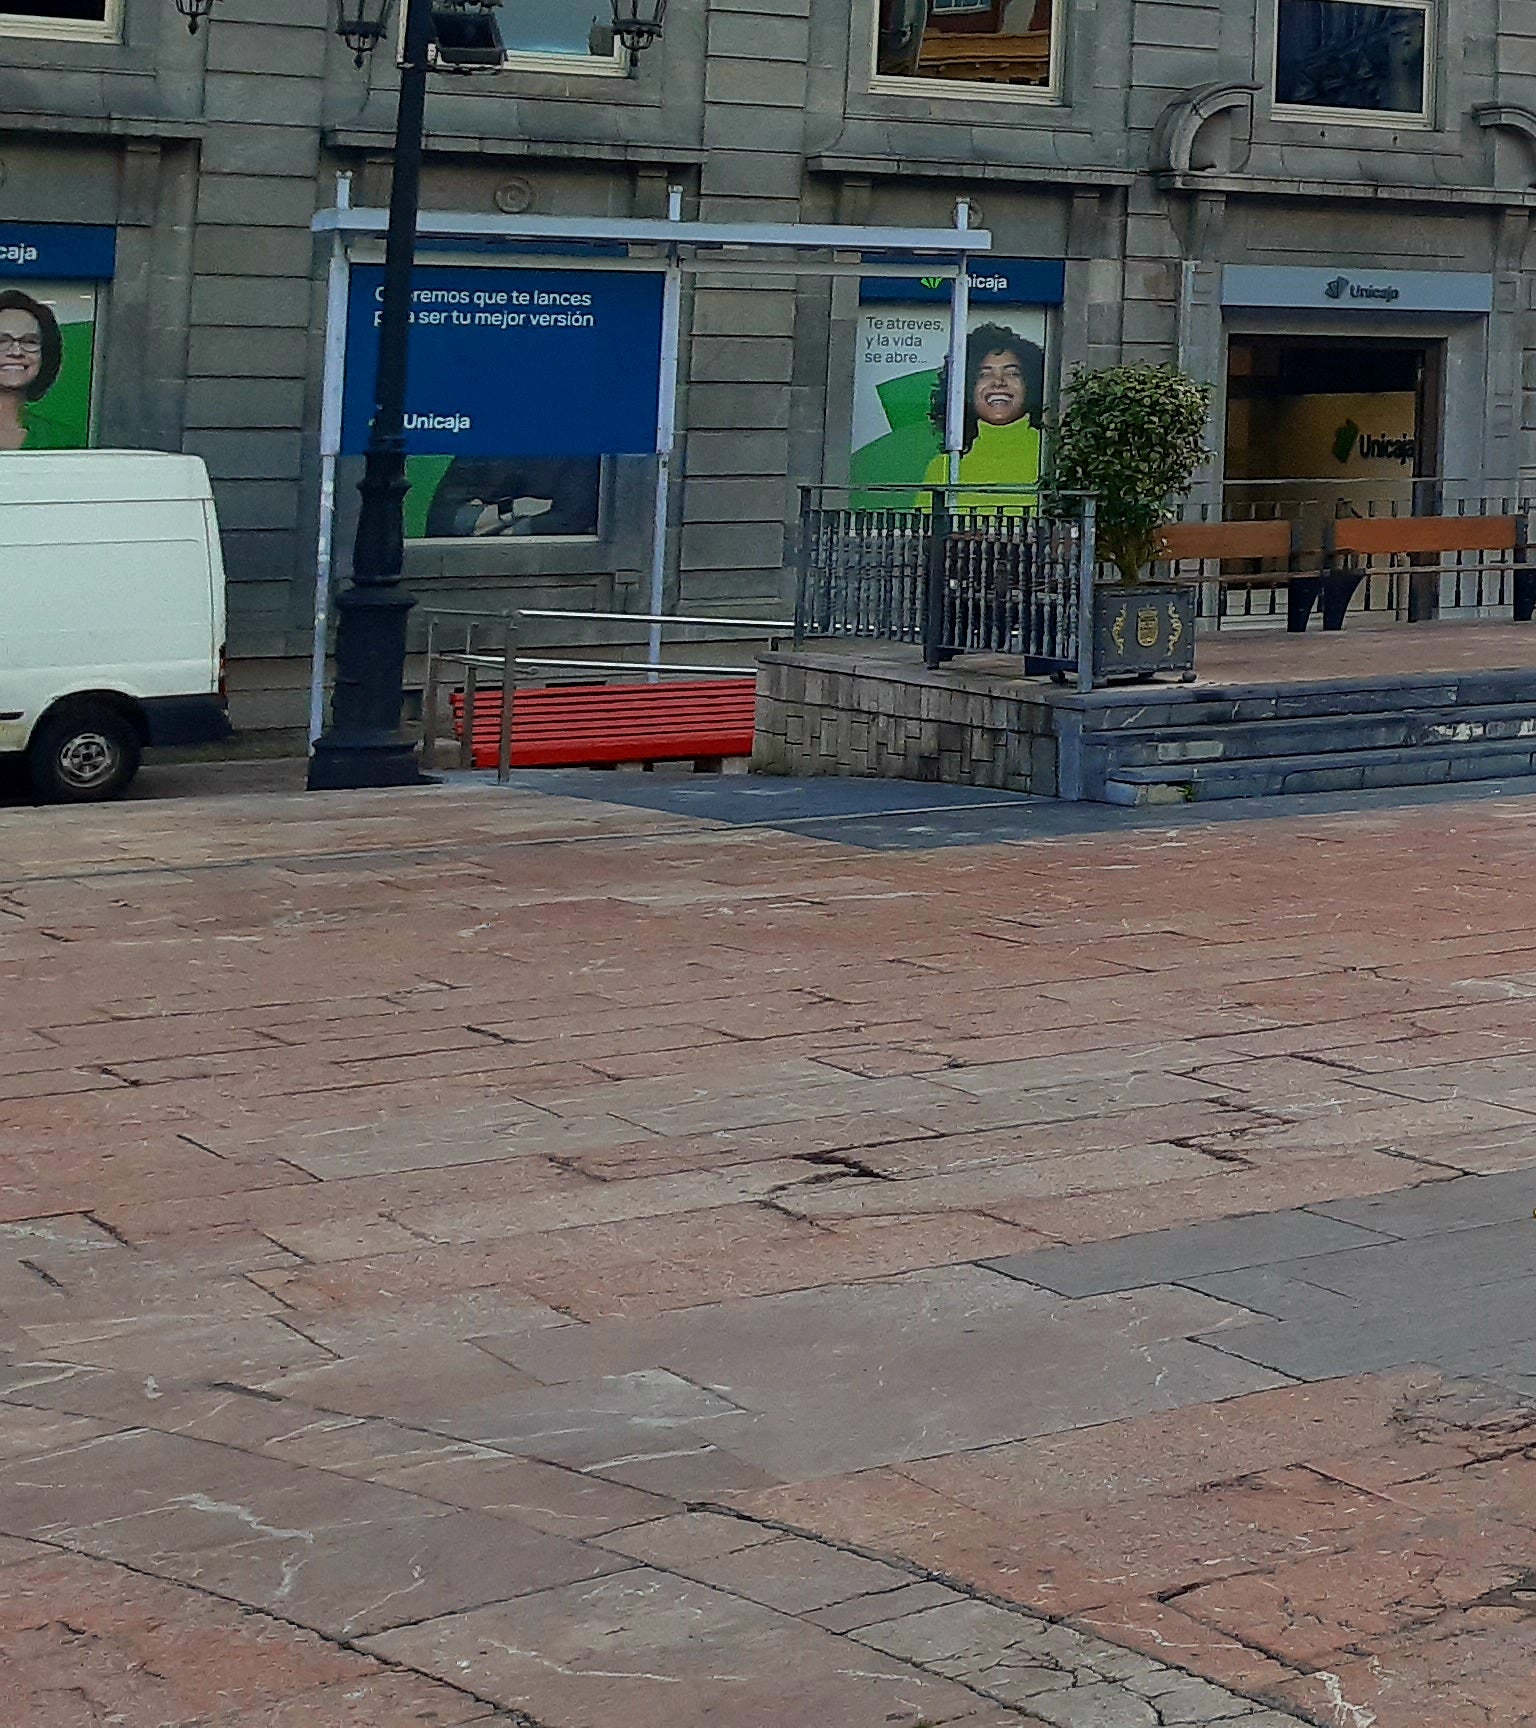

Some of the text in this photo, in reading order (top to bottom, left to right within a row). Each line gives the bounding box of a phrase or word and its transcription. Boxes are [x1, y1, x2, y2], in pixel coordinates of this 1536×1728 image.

[967, 273, 1008, 292] nicaja
[374, 286, 592, 308] remos que te lances
[1349, 285, 1400, 303] Unicaja
[419, 312, 449, 325] ser
[451, 310, 471, 325] tu
[475, 311, 524, 329] mejor
[529, 310, 594, 327] versión
[866, 316, 945, 333] Te atreves,
[865, 334, 923, 349] y la vida
[864, 353, 882, 363] se
[403, 413, 471, 433] Unicaja
[1359, 432, 1415, 465] Unicaja
